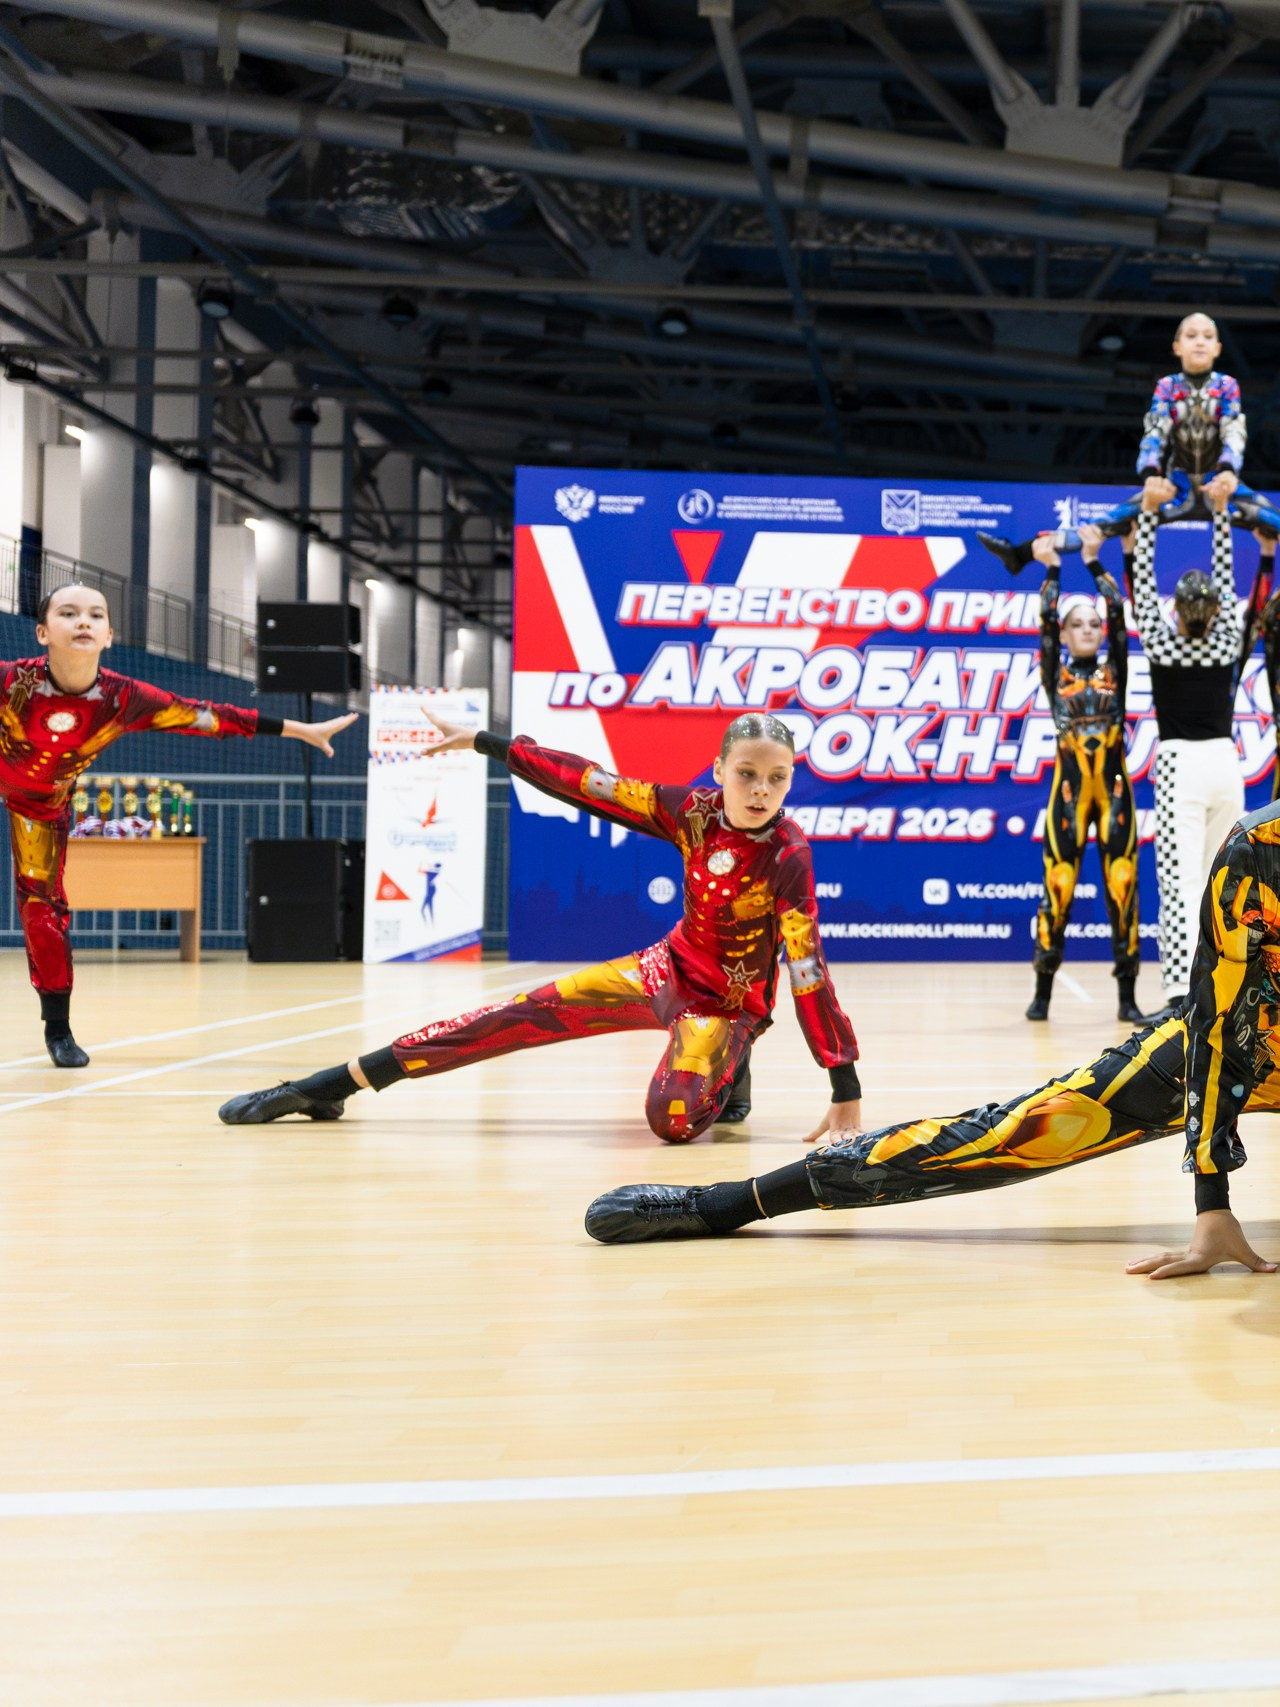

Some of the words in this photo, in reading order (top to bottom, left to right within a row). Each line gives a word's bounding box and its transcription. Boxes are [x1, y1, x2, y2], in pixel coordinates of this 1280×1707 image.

[616, 582, 927, 630] ПЕРВЕНСТВО
[897, 808, 997, 842] 2026
[818, 922, 1012, 939] WW.ROCKNROLLPRIM.RU
